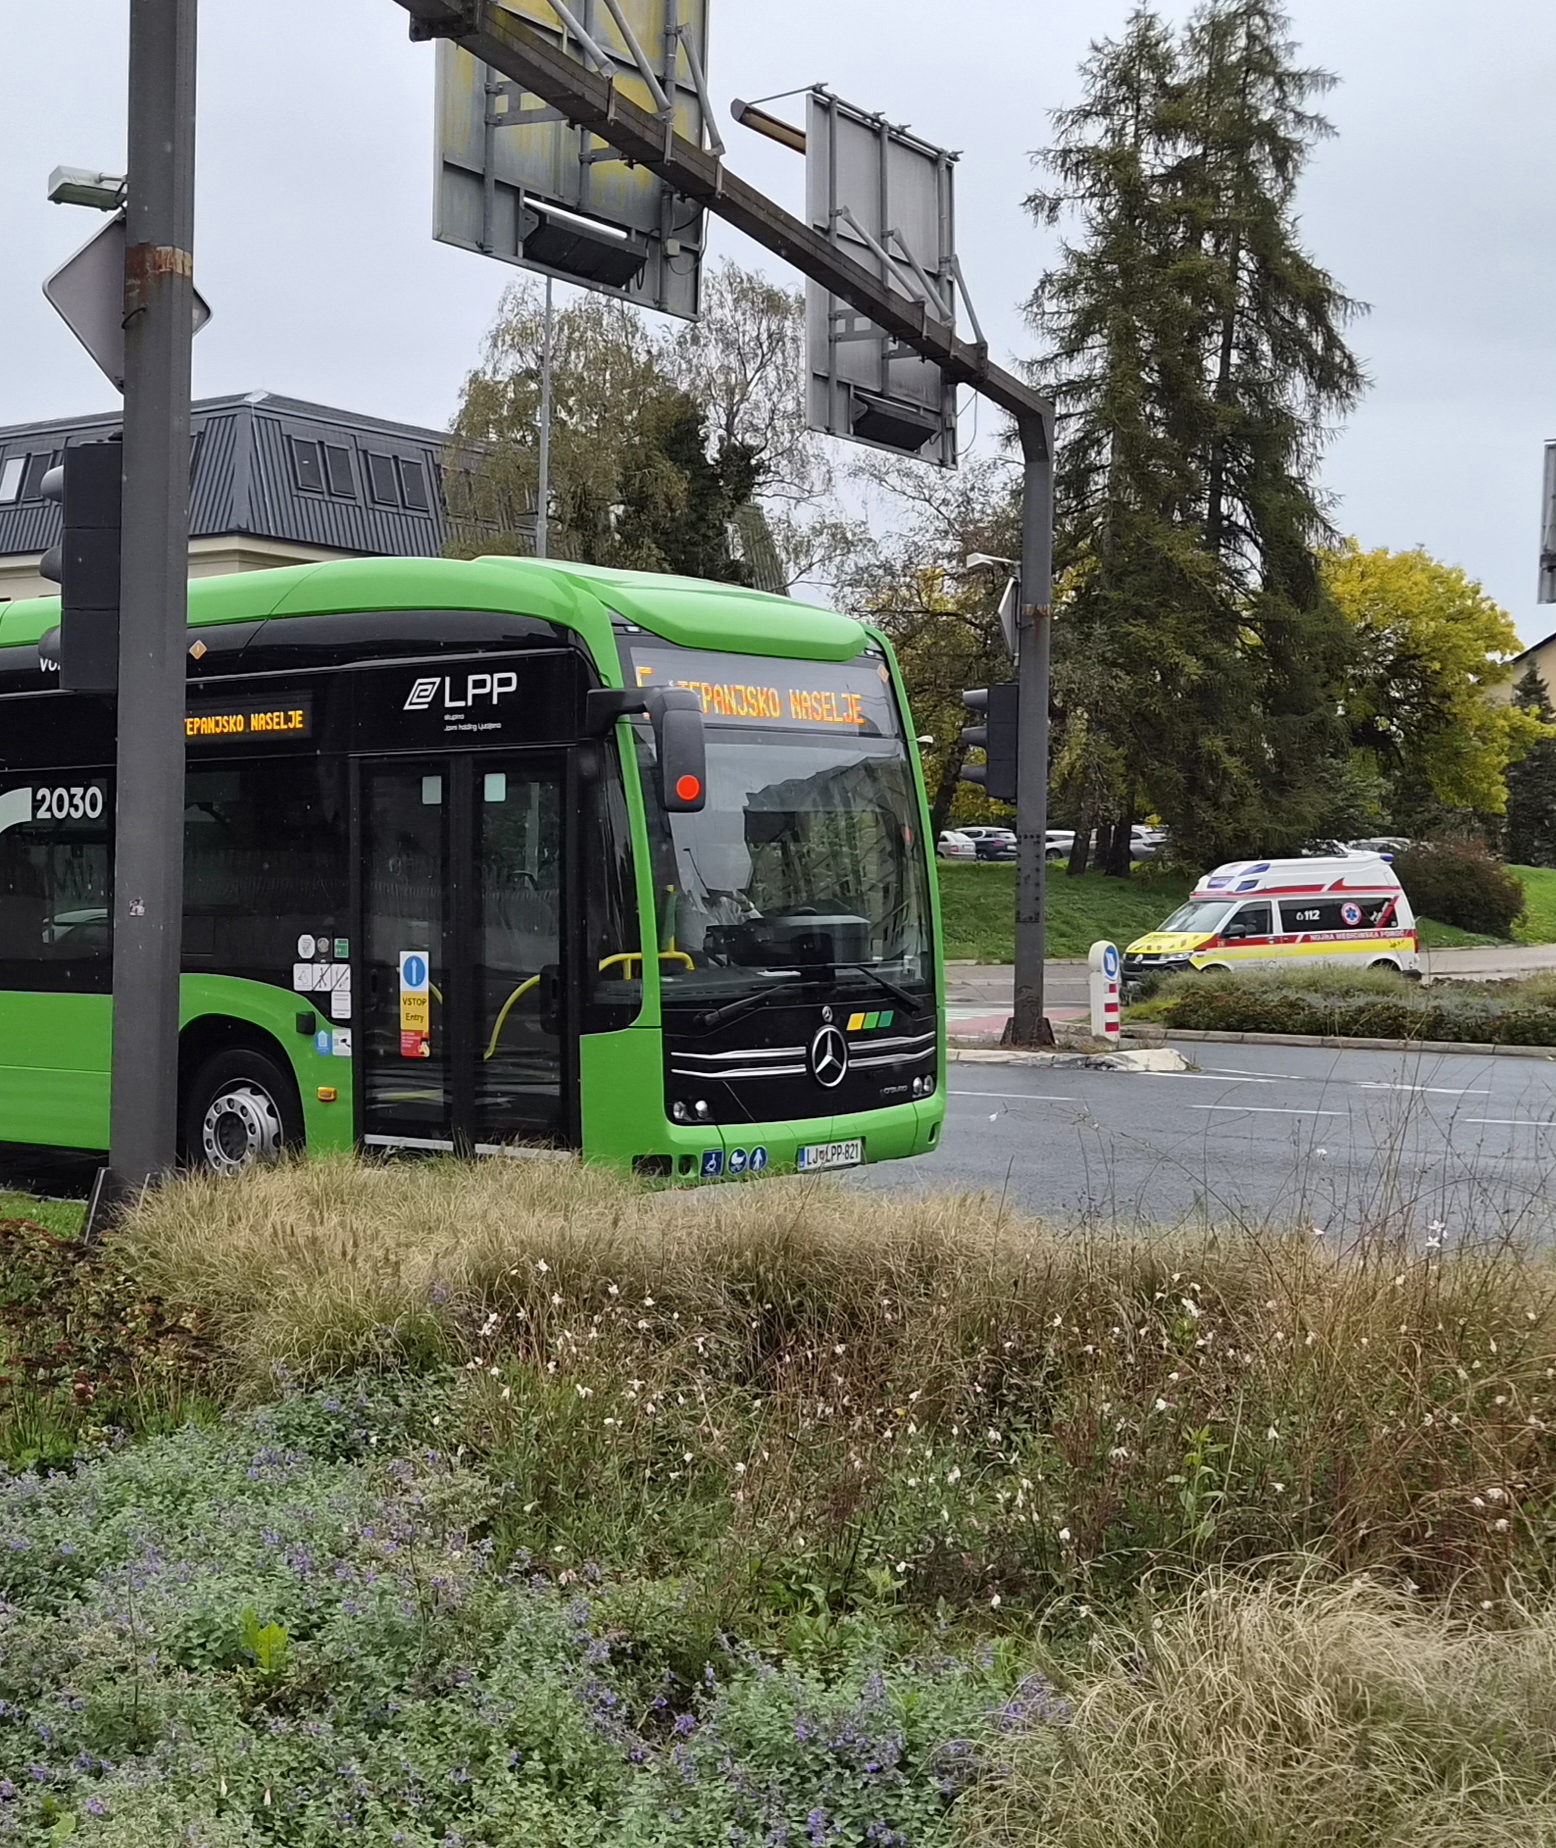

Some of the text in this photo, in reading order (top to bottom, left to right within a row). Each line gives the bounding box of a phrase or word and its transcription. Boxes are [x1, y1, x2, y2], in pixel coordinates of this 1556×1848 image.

[444, 672, 518, 708] LPP
[789, 688, 866, 724] NASELJE
[184, 710, 303, 735] EPANJSKO NASELJE
[35, 786, 103, 819] 2030
[1304, 909, 1321, 920] 112
[402, 997, 427, 1006] VSTOP
[405, 1012, 425, 1024] Entry
[806, 1143, 859, 1166] LJ LPP-821
